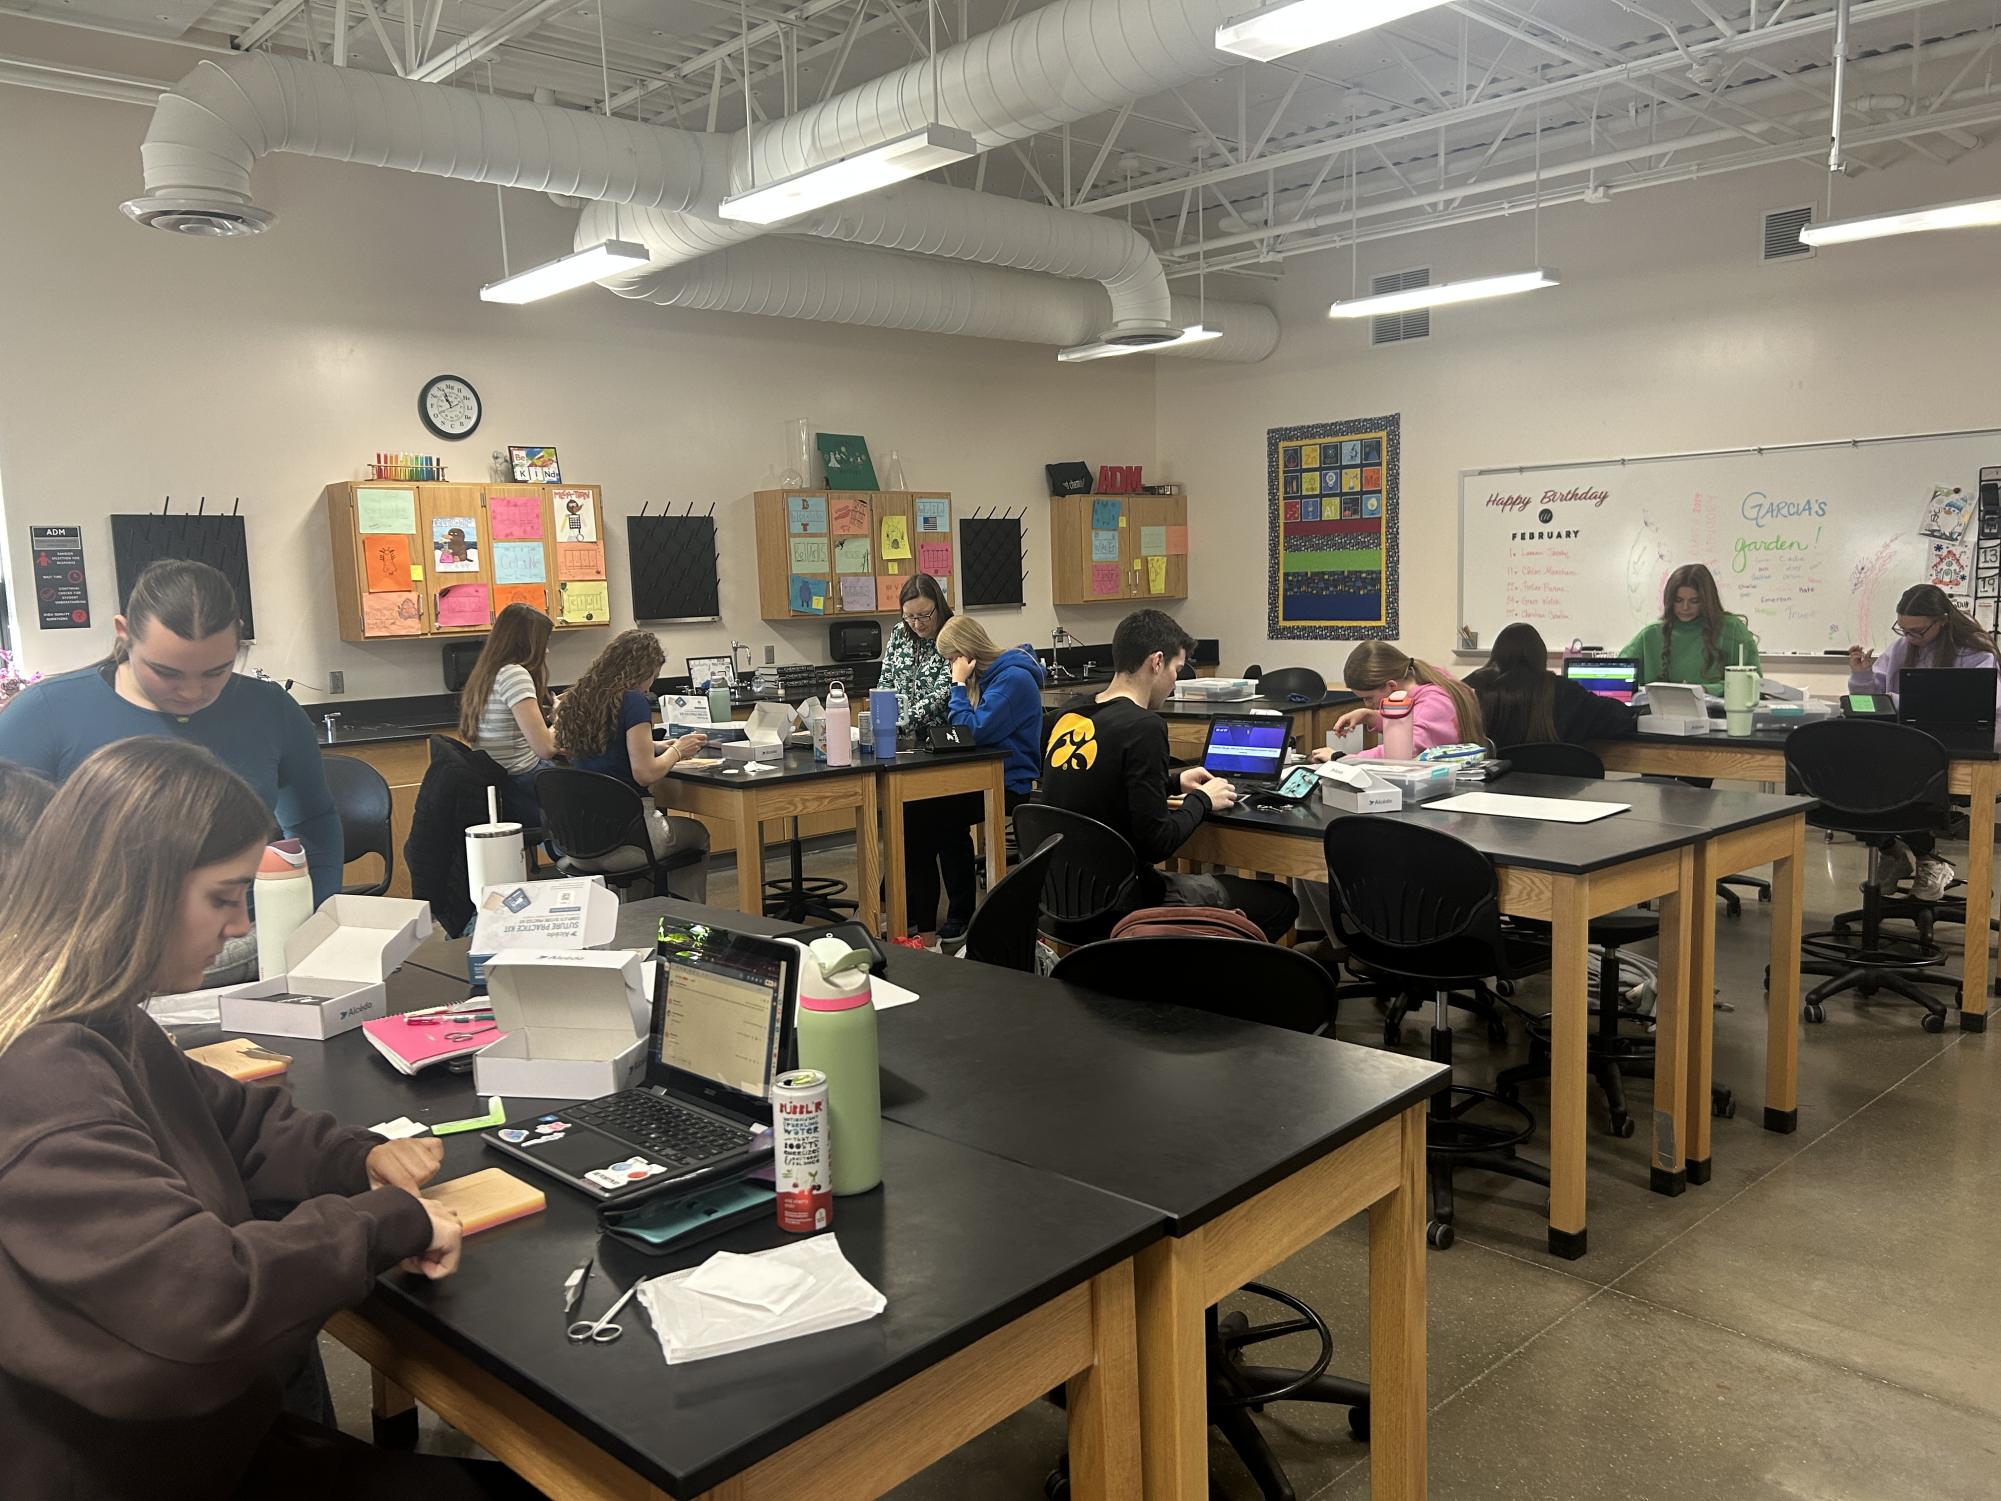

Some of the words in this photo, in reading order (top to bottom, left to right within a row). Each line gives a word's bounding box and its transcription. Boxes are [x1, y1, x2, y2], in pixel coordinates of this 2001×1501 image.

[514, 453, 526, 462] Be
[1097, 465, 1143, 493] ADM
[1486, 492, 1531, 513] Happy
[1540, 486, 1609, 508] Birthday
[1742, 491, 1828, 528] GARCIA'S
[46, 528, 66, 536] ADM
[1511, 530, 1580, 541] FEBRUARY
[1981, 549, 1998, 564] 13
[1980, 577, 1996, 593] 19
[503, 925, 516, 933] KIT
[516, 923, 551, 932] PRACTICE
[552, 921, 580, 929] SUTURE
